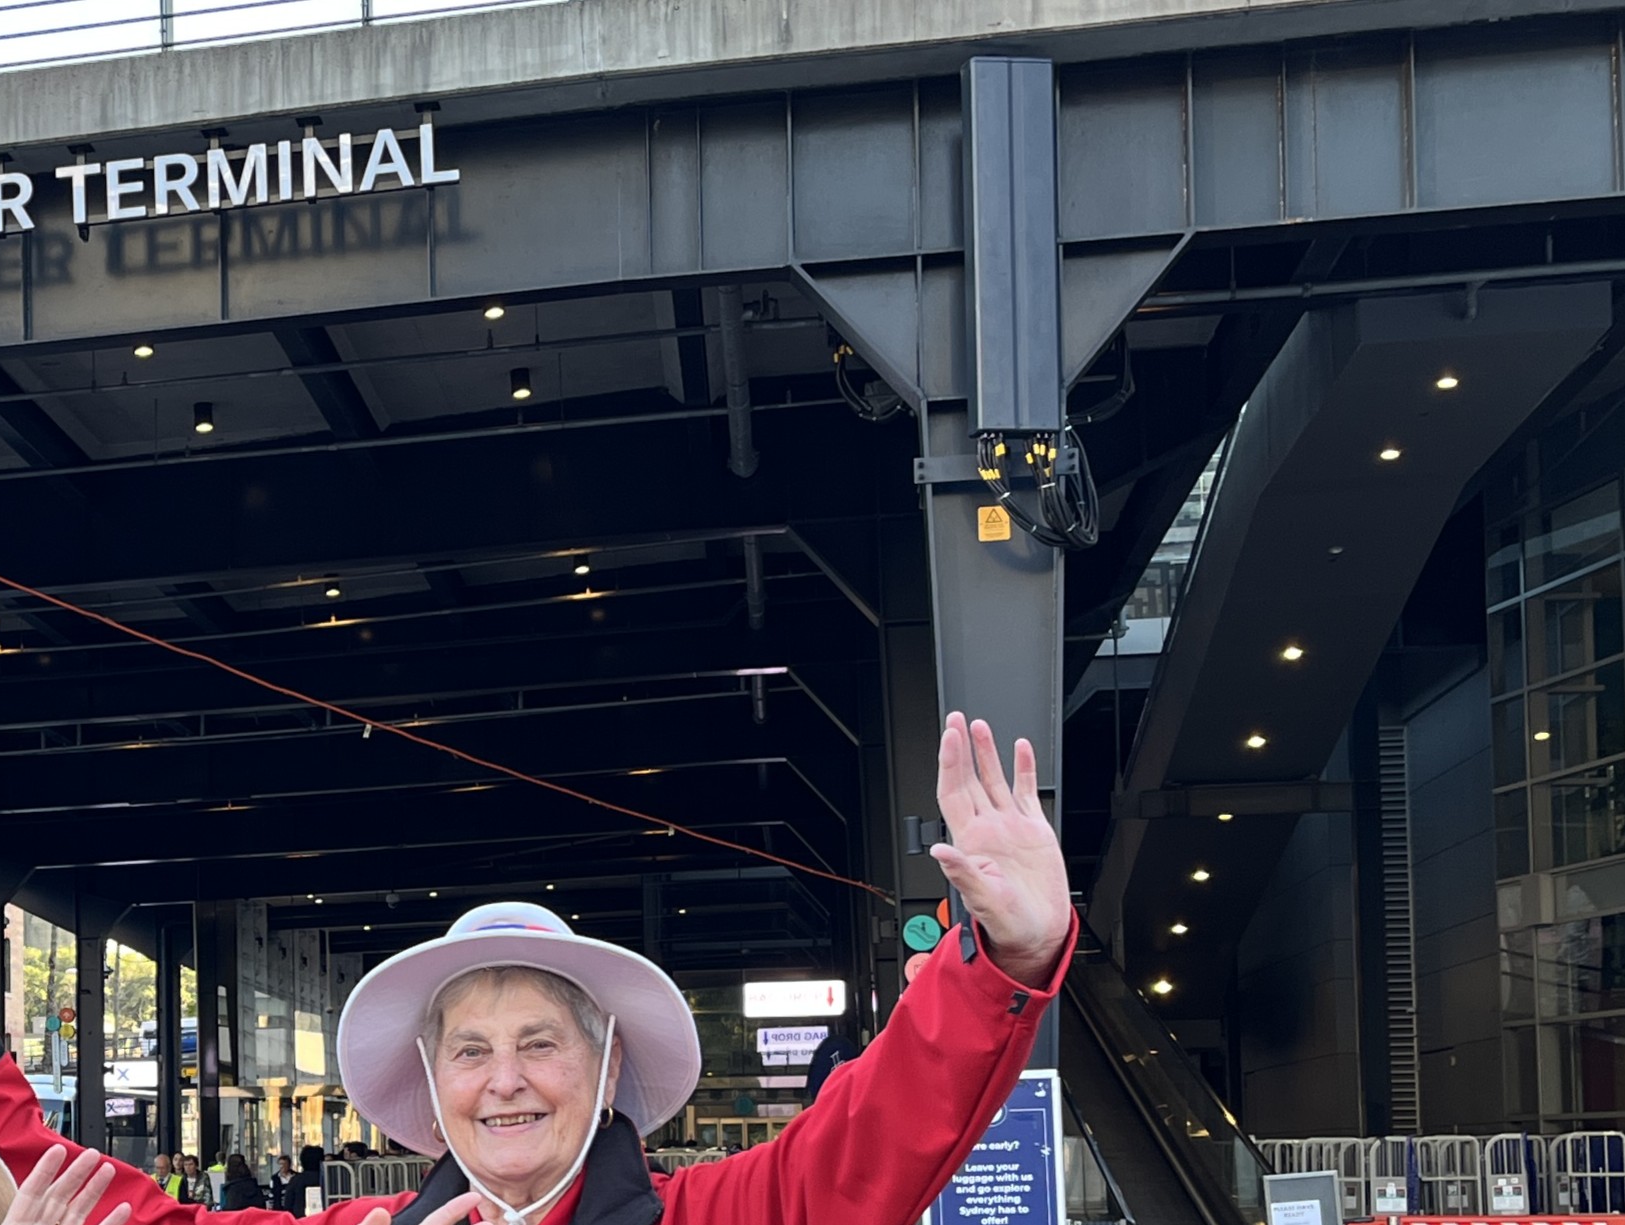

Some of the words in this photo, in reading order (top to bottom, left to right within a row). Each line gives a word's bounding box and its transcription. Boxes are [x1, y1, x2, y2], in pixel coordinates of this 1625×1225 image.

[55, 122, 461, 225] TERMINAL
[988, 1141, 1020, 1152] early?
[965, 1164, 994, 1172] Leave
[996, 1163, 1020, 1173] your
[952, 1174, 994, 1184] luggage
[996, 1173, 1019, 1181] with
[956, 1185, 975, 1194] and
[977, 1187, 991, 1195] go
[993, 1184, 1031, 1194] explore
[966, 1195, 1022, 1205] everything
[959, 1206, 996, 1216] Sydney
[998, 1206, 1016, 1214] has
[1018, 1206, 1030, 1214] to
[981, 1216, 1008, 1225] offer!
